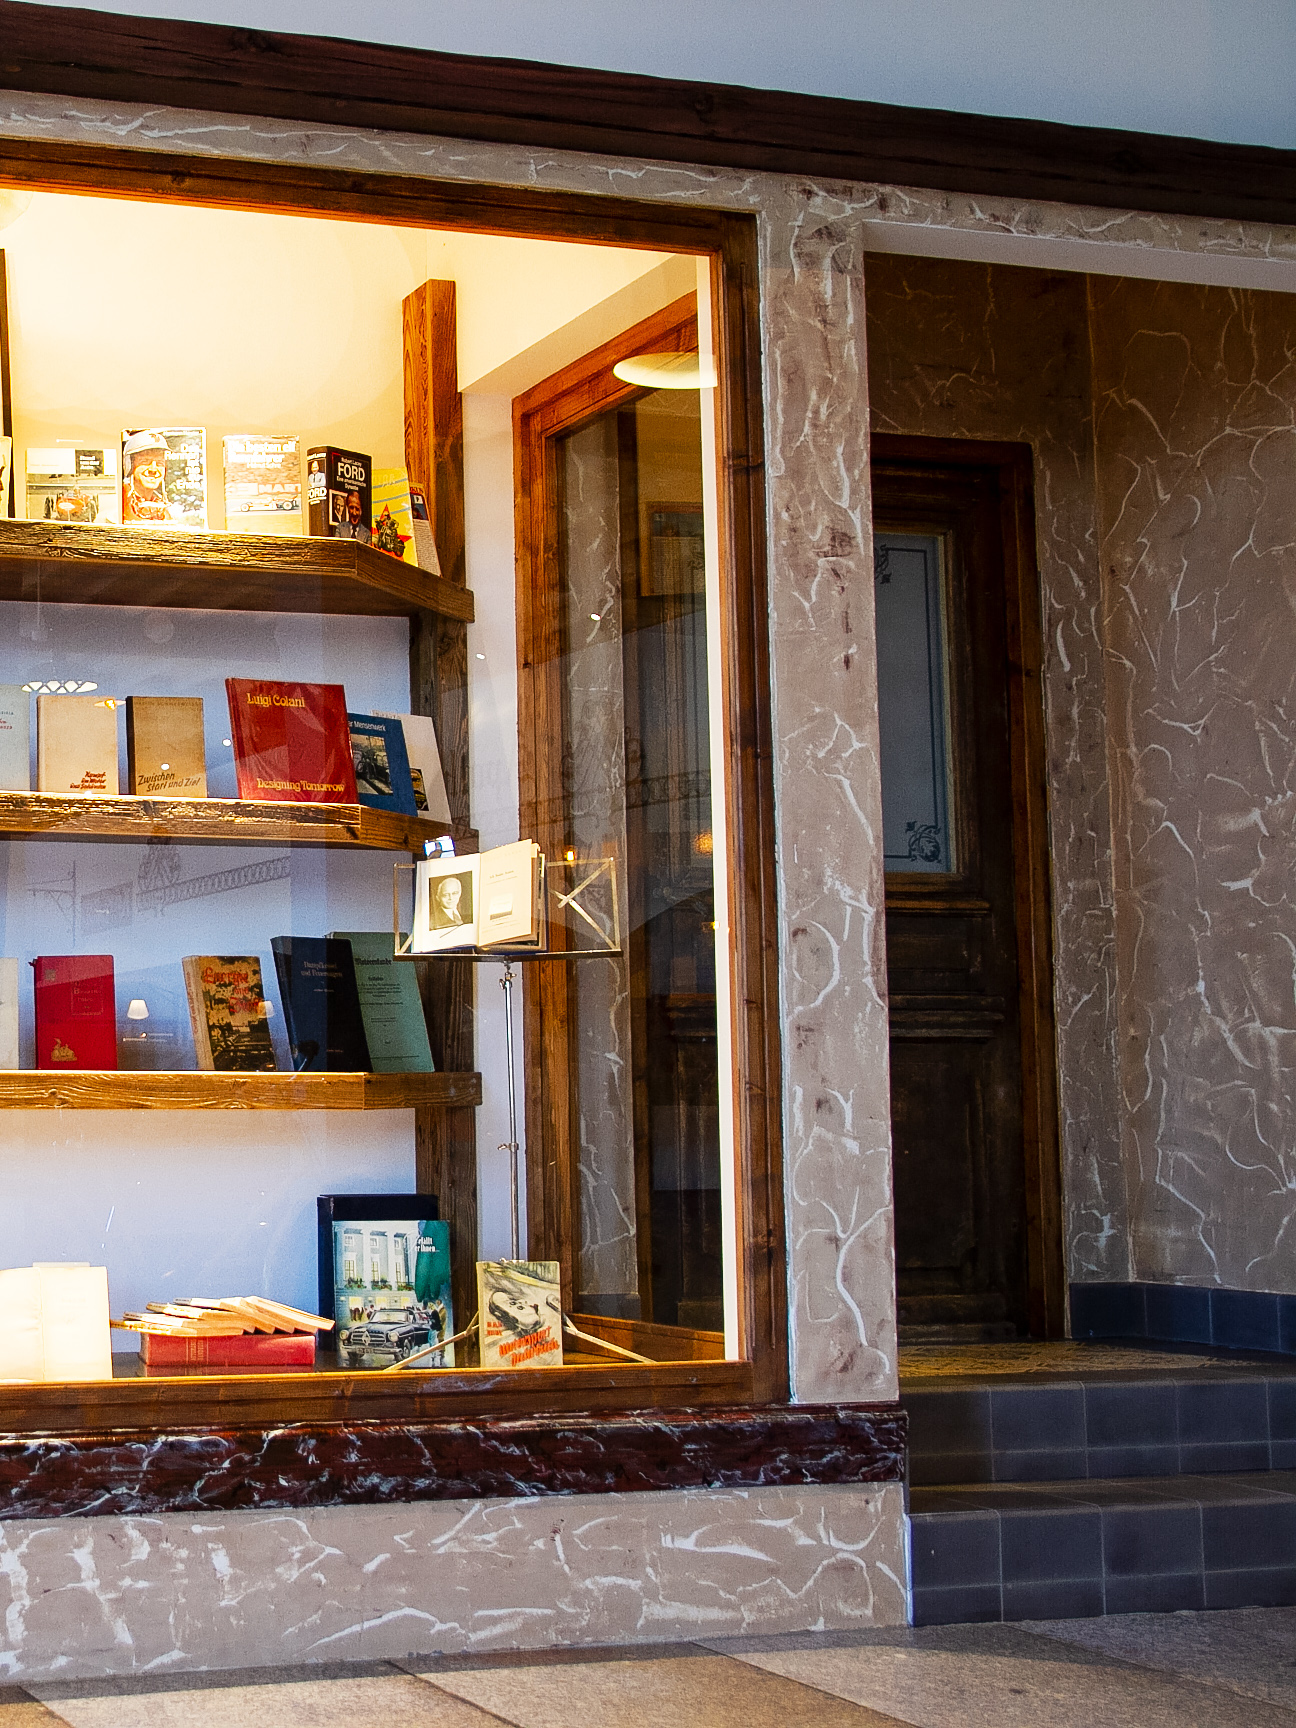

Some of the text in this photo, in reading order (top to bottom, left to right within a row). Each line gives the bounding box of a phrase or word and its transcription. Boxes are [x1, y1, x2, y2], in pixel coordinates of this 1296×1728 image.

[245, 440, 282, 453] besten
[282, 440, 297, 452] elf
[337, 462, 365, 481] FORD
[246, 692, 306, 708] Luigi Colani
[137, 772, 176, 786] Zwischen
[146, 777, 201, 792] Start und Ziel
[256, 778, 345, 792] Designing Tomorrow
